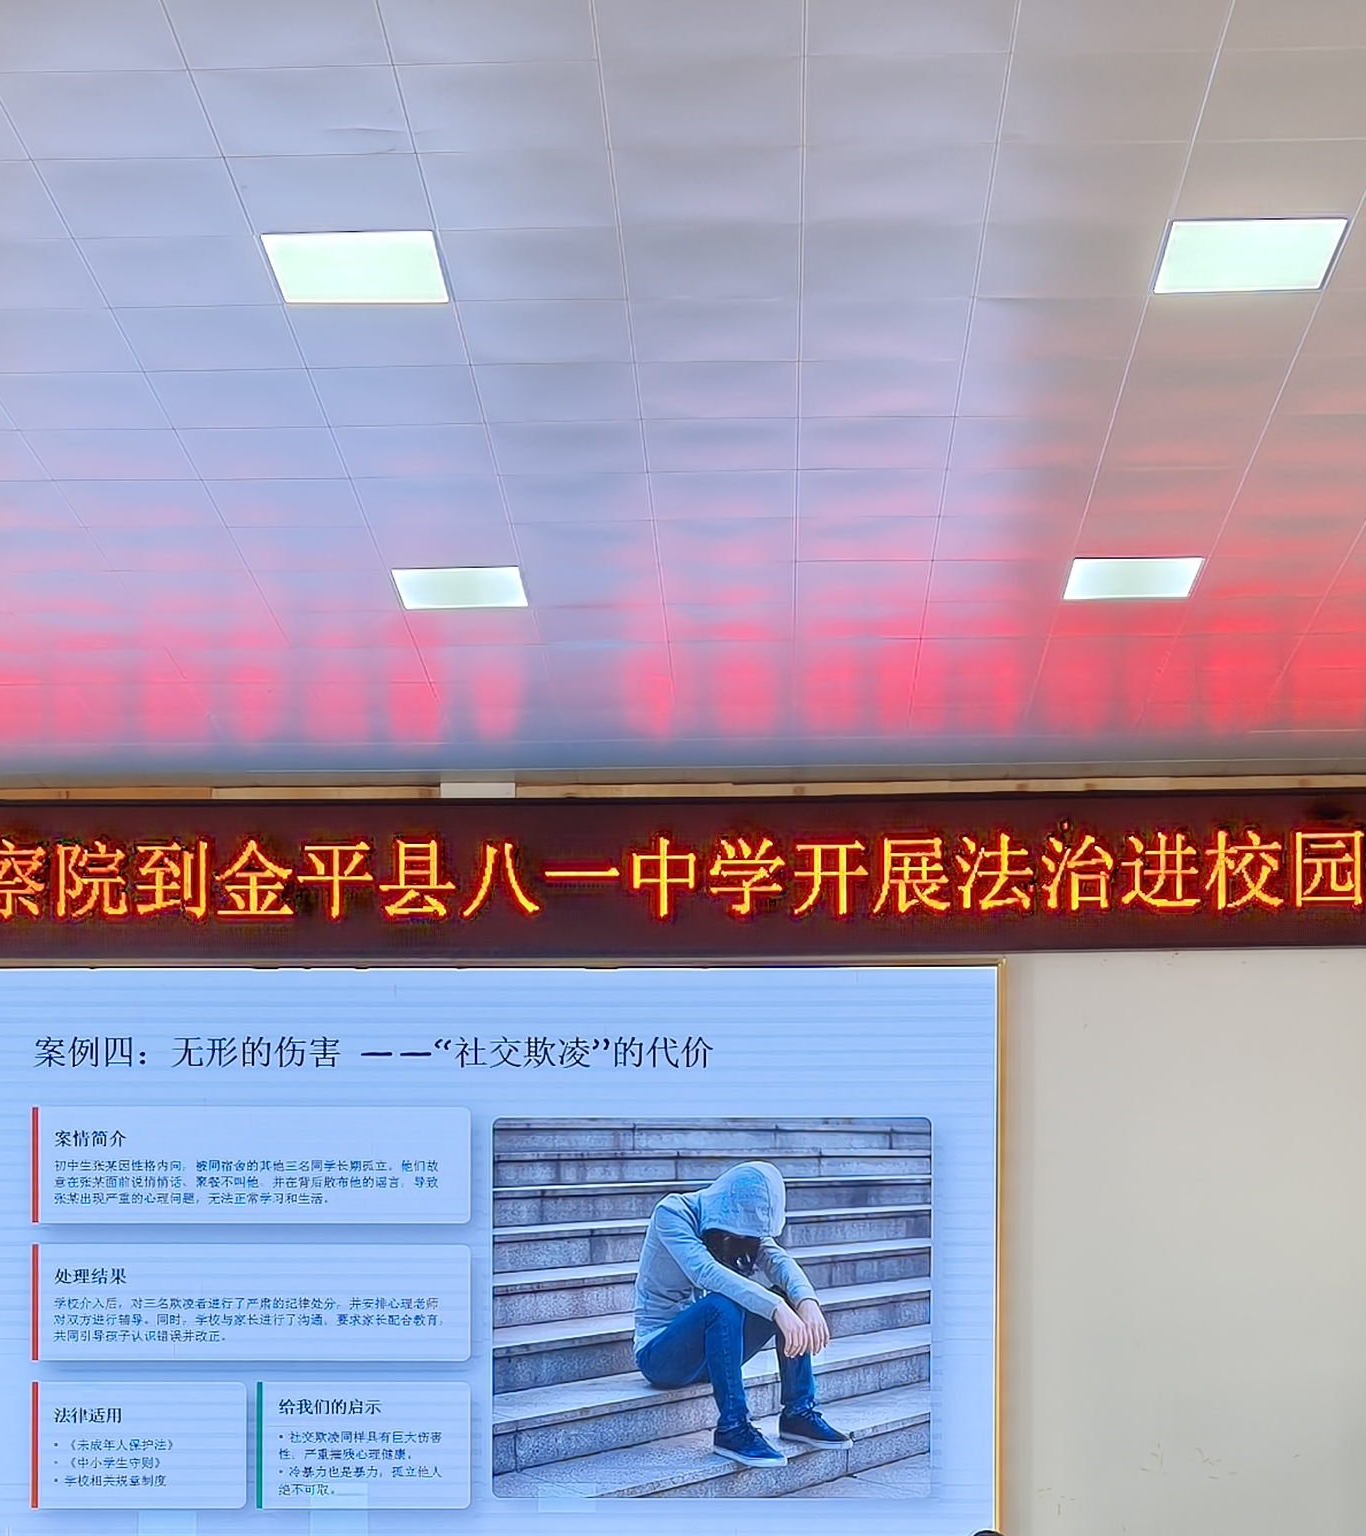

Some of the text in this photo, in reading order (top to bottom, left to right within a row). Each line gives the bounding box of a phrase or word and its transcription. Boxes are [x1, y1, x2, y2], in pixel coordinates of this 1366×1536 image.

[54, 1129, 127, 1148] 案情简介
[54, 1267, 128, 1285] 处理结果
[53, 1406, 122, 1424] 法律适用
[278, 1398, 383, 1416] 给我们的启示
